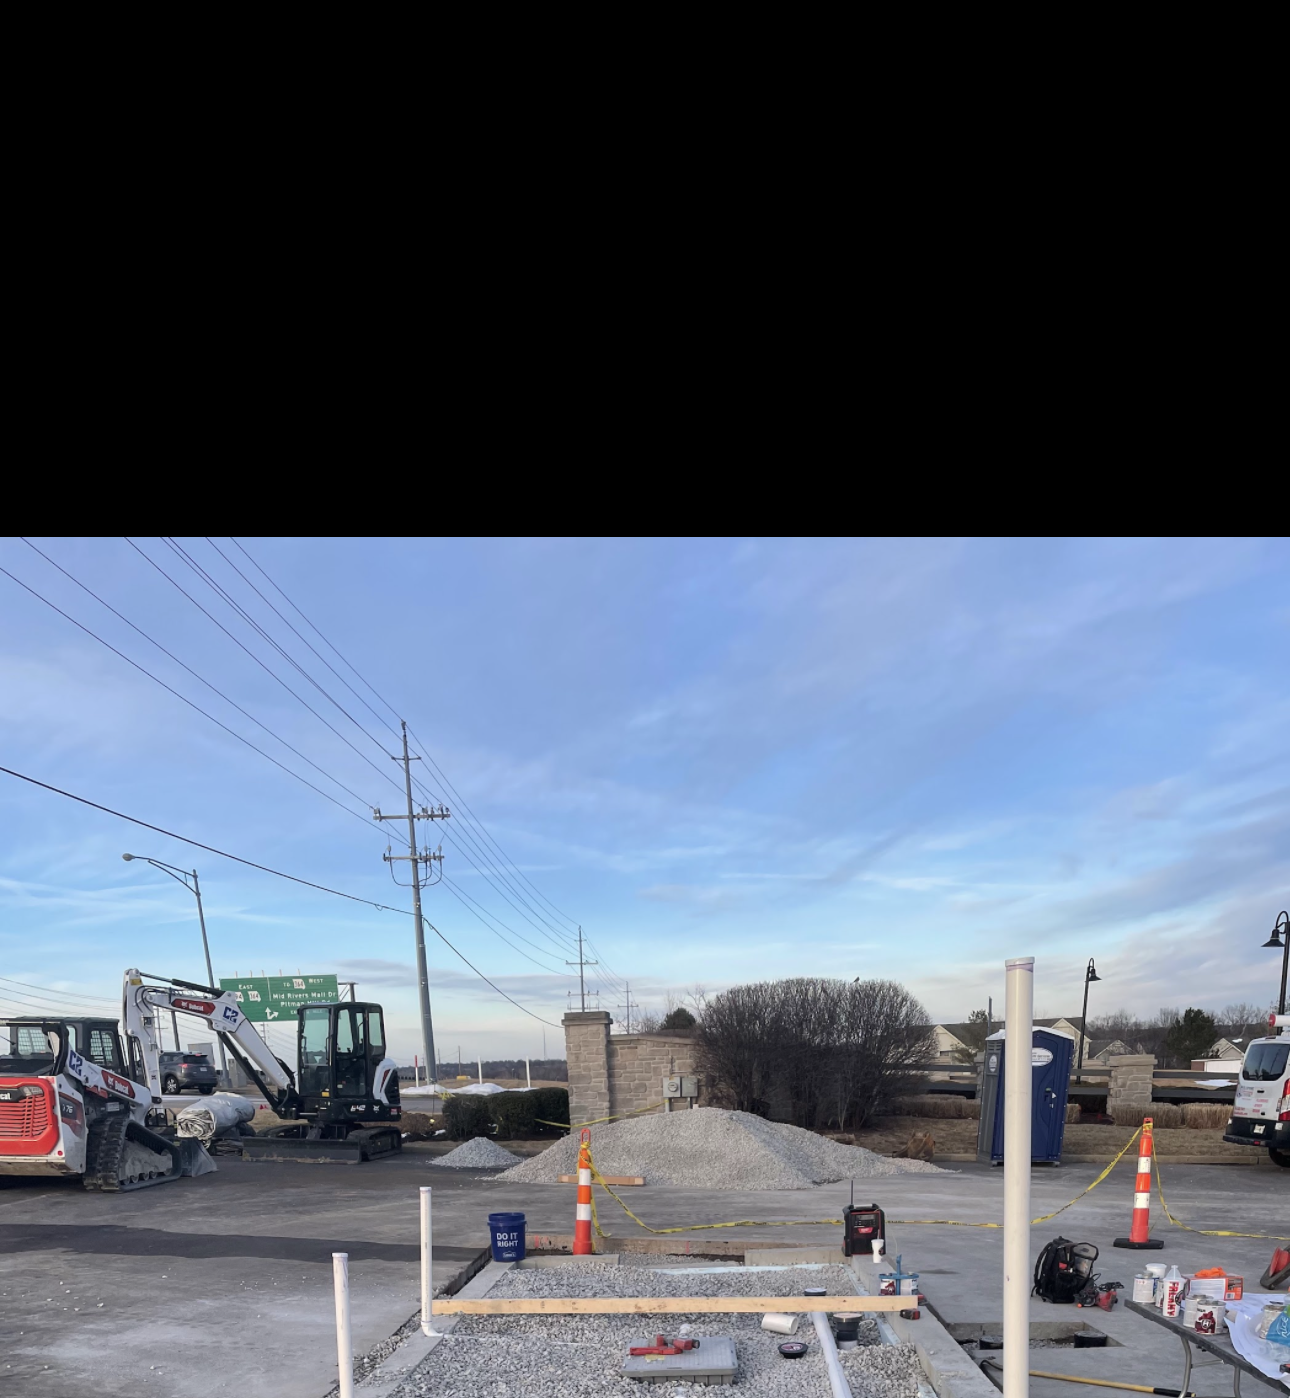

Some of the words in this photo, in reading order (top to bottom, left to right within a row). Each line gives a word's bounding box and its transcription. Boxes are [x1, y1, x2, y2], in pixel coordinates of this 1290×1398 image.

[287, 991, 309, 999] Rivers
[496, 1232, 508, 1240] DO
[510, 1232, 518, 1240] IT
[497, 1240, 519, 1248] RIGHT
